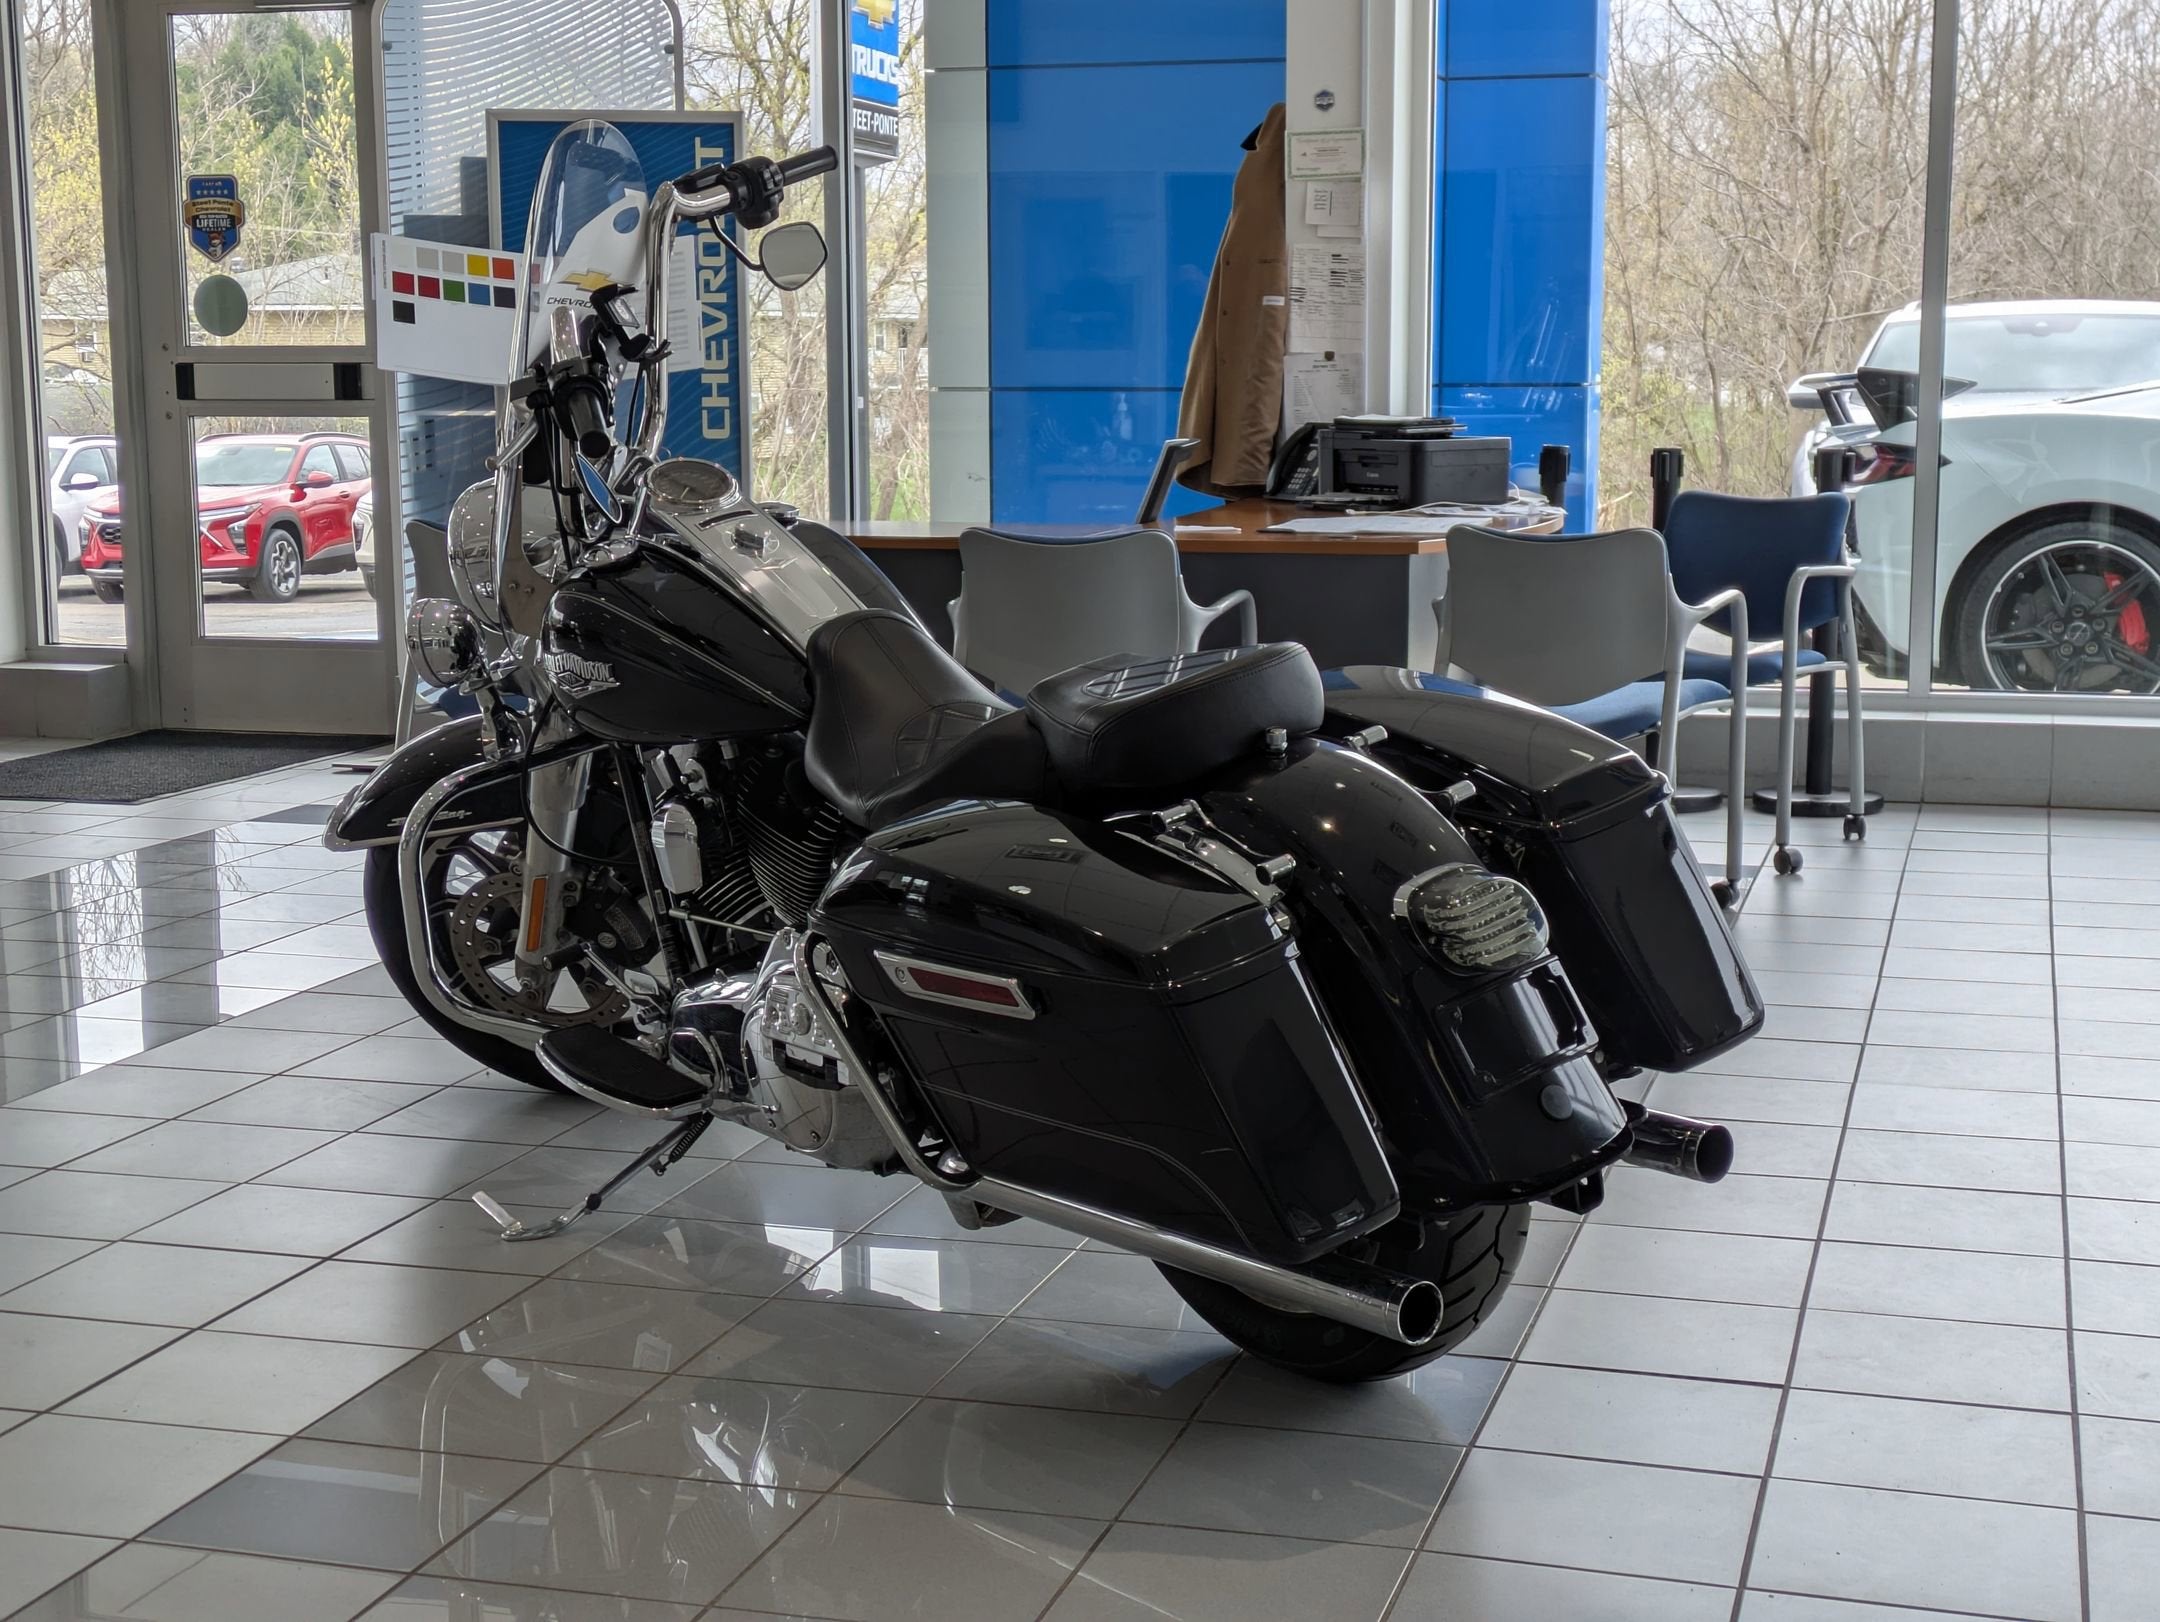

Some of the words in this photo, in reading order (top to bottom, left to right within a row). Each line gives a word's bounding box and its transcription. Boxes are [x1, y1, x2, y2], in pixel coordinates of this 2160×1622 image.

[852, 108, 899, 137] TEET-PONTE
[196, 218, 232, 228] LIFETIME
[694, 136, 731, 441] CHEVROT
[546, 297, 594, 309] CHEVRO
